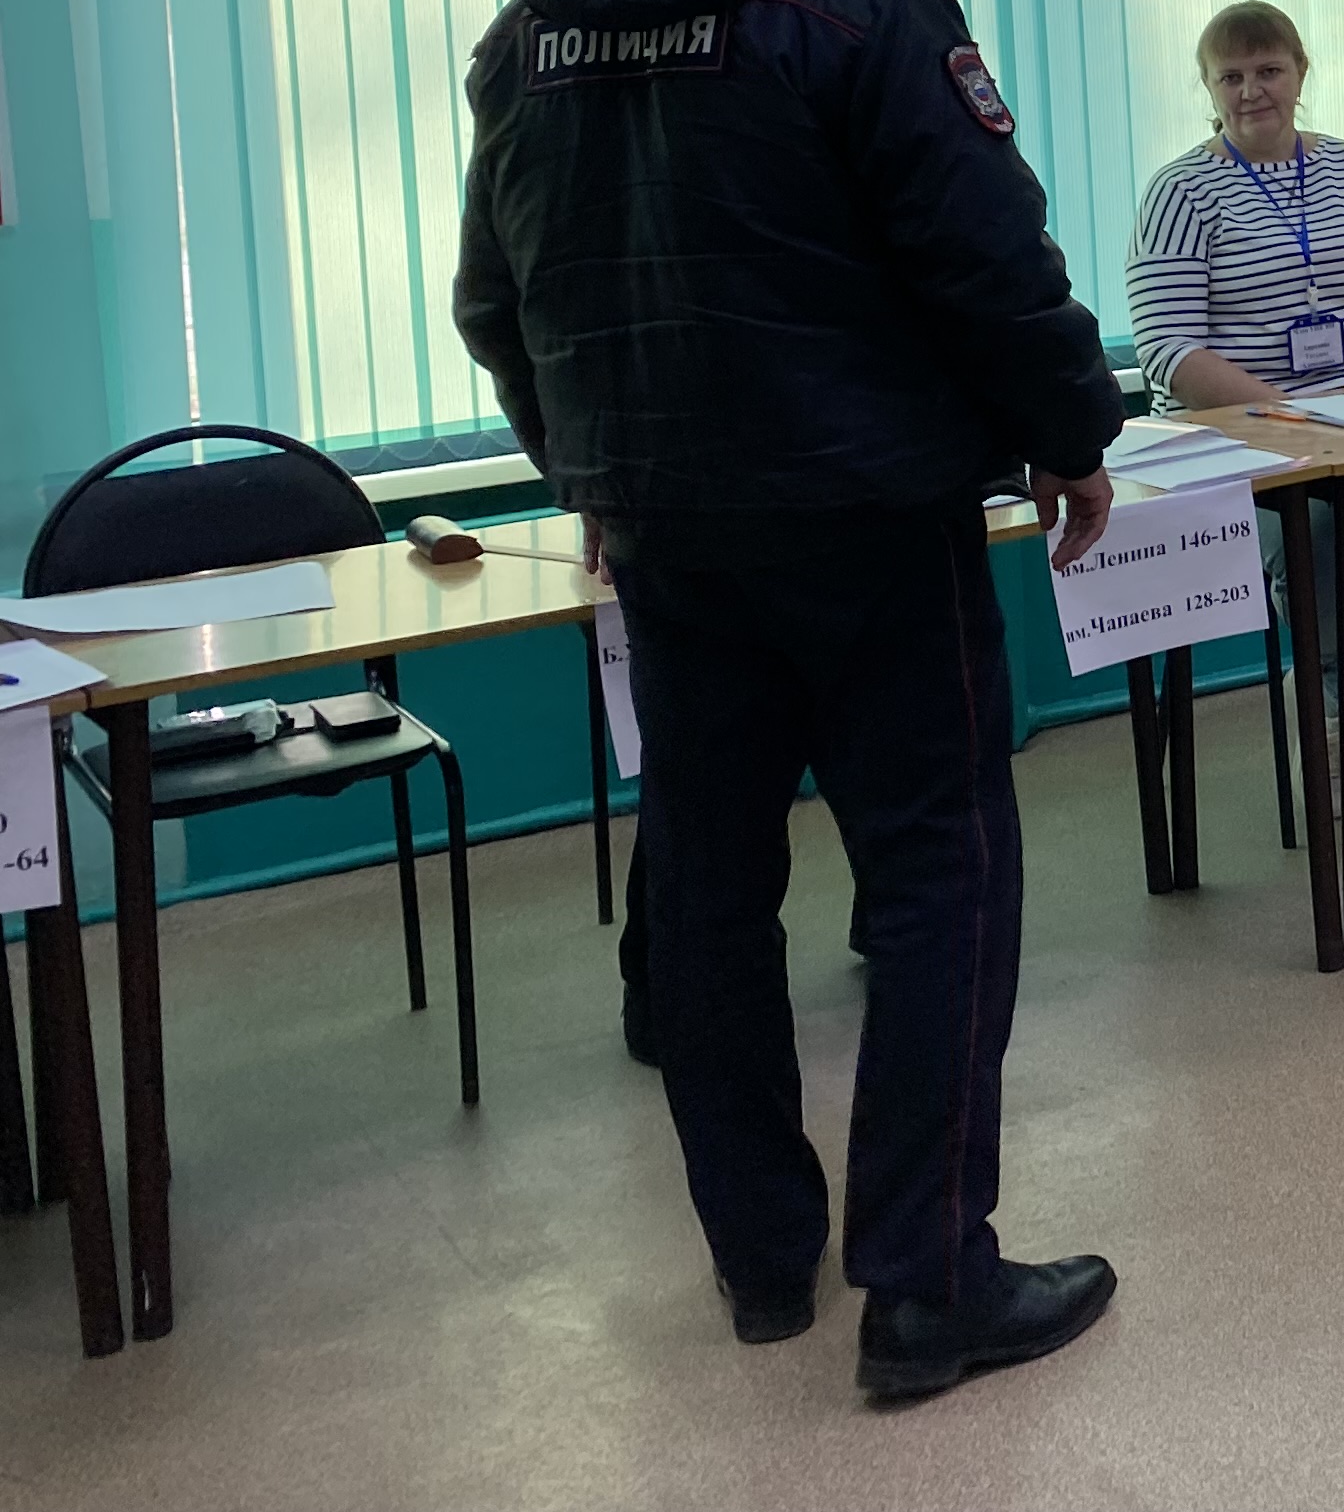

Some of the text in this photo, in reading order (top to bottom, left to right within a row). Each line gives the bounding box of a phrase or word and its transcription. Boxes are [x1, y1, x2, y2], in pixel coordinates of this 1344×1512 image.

[537, 14, 716, 73] ПОЛИЦИЯ
[1180, 520, 1251, 552] 146-198
[1185, 584, 1250, 613] 128-203
